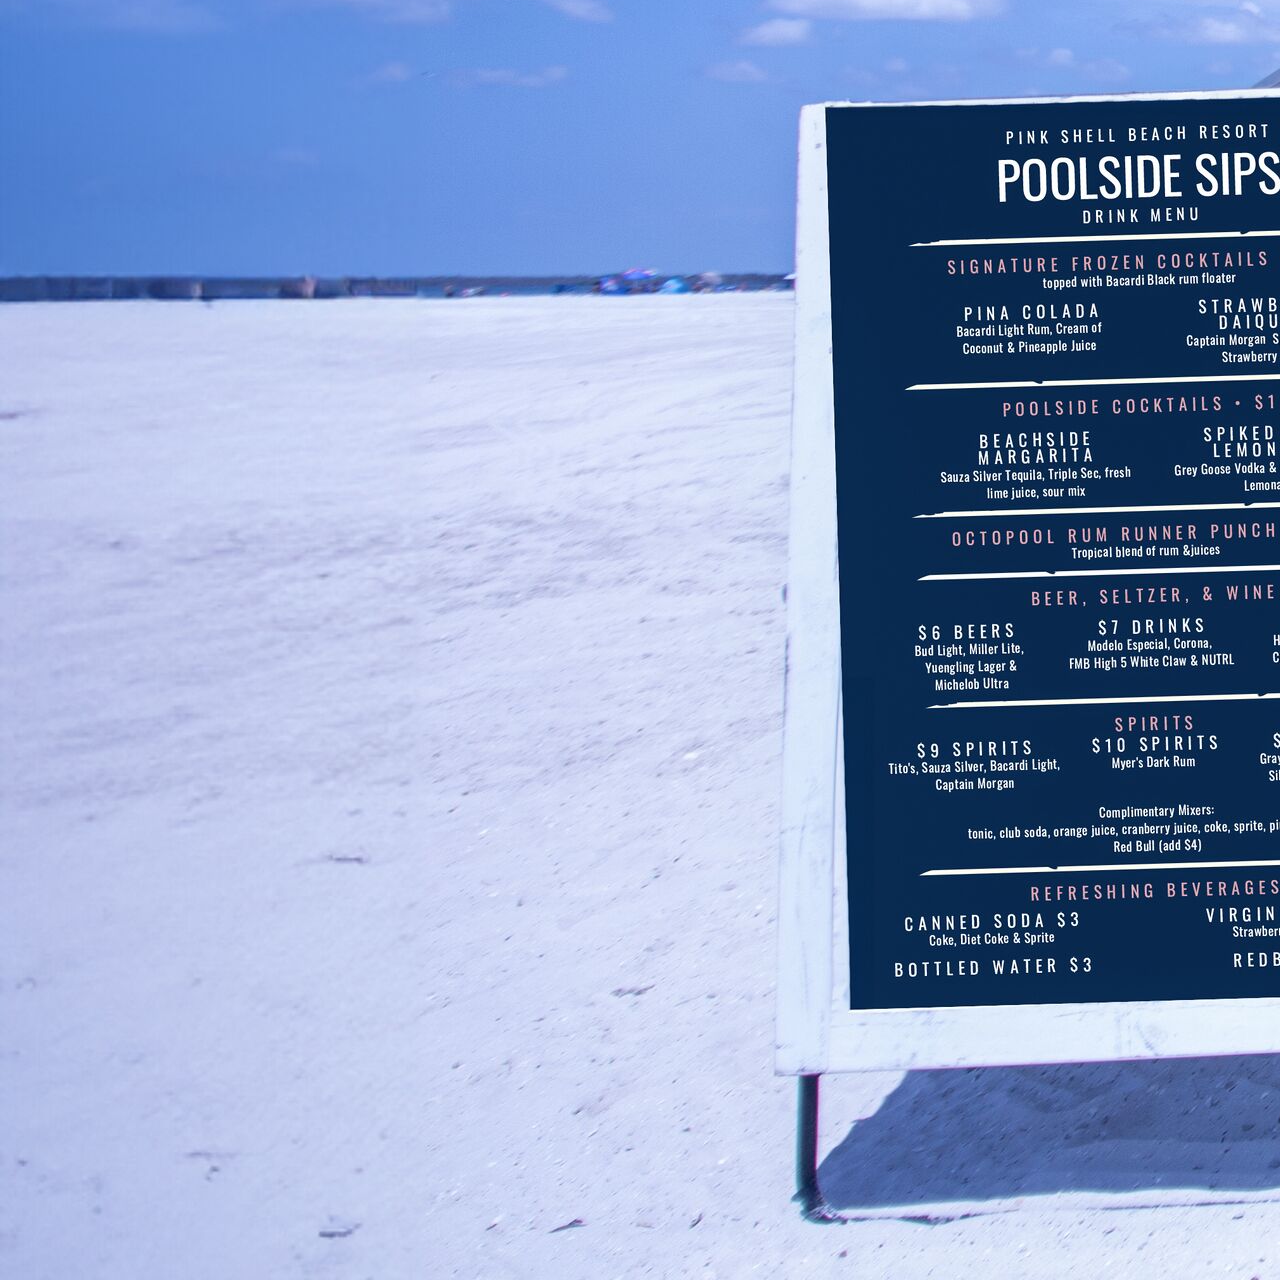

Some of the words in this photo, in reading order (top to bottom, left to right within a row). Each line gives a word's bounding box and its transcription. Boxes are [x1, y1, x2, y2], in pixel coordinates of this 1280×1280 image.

[1005, 130, 1049, 145] PINK
[1060, 128, 1116, 144] SHELL
[1128, 125, 1186, 142] BEACH
[1199, 123, 1269, 140] RESORT
[997, 153, 1183, 203] POOLSIDE
[1082, 208, 1139, 225] DRINK
[1150, 206, 1199, 223] MENU
[947, 257, 1058, 275] SIGNATURE
[1071, 254, 1144, 272] FROZEN
[1157, 250, 1267, 270] COCKTAILS
[1042, 275, 1077, 291] topped
[1080, 275, 1103, 288] with
[1105, 274, 1145, 287] Bacardi
[1147, 273, 1176, 286] Black
[1178, 275, 1199, 285] rum
[1201, 271, 1237, 284] floater
[964, 305, 1009, 322] PINA
[1022, 302, 1099, 320] COLADA
[956, 324, 996, 338] Bacardi
[998, 323, 1025, 338] Light
[1027, 323, 1053, 336] Rum,
[1055, 322, 1089, 335] Cream
[1091, 321, 1103, 334] of
[962, 342, 1004, 355] Coconut
[1007, 341, 1015, 354] &
[1018, 339, 1068, 355] Pineapple
[1070, 339, 1097, 352] Juice
[1186, 334, 1226, 349] Captain
[1229, 333, 1266, 348] Morgan
[1221, 350, 1278, 364] Strawberry
[1002, 399, 1099, 418] POOLSIDE
[1112, 395, 1222, 415] COCKTAILS
[979, 430, 1090, 449] BEACHSIDE
[1203, 425, 1274, 443] SPIKED
[978, 447, 1093, 466] MARGARITA
[940, 471, 970, 484] Sauza
[972, 470, 1003, 482] Silver
[1004, 468, 1045, 484] Tequila,
[1047, 467, 1078, 482] Triple
[1080, 466, 1102, 480] Sec,
[1104, 465, 1131, 479] fresh
[1174, 464, 1198, 478] Grey
[1200, 463, 1231, 476] Goose
[1234, 461, 1266, 475] Vodka
[1268, 461, 1277, 474] &
[952, 528, 1055, 547] OCTOPOOL
[1068, 527, 1107, 544] RUM
[1121, 524, 1197, 542] RUNNER
[1210, 522, 1275, 539] PUNCH
[1071, 546, 1113, 561] Tropical
[1115, 545, 1143, 558] blend
[1145, 545, 1156, 557] of
[1159, 546, 1180, 557] rum
[1182, 544, 1221, 558] &juices
[1031, 590, 1086, 607] BEER,
[1099, 587, 1189, 605] SELTZER,
[1202, 586, 1213, 601] &
[1226, 584, 1275, 601] WINE
[918, 624, 941, 641] $6
[954, 622, 1014, 640] BEERS
[1098, 619, 1119, 636] $7
[1132, 617, 1204, 635] DRINKS
[914, 644, 934, 657] Bud
[937, 643, 966, 658] Light,
[969, 642, 999, 655] Miller
[1001, 642, 1025, 656] Lite,
[1087, 639, 1124, 652] Modelo
[1126, 637, 1171, 653] Especial,
[1173, 637, 1213, 650] Corona,
[924, 660, 975, 676] Yuengling
[977, 660, 1007, 675] Lager
[1009, 659, 1017, 672] &
[935, 677, 980, 691] Michelob
[982, 677, 1010, 690] Ultra
[1114, 715, 1193, 733] SPIRITS
[916, 742, 939, 760] $9
[952, 739, 1032, 757] SPIRITS
[1091, 737, 1126, 754] $10
[1139, 734, 1218, 752] SPIRITS
[888, 762, 919, 776] Tito's,
[921, 761, 951, 774] Sauza
[954, 760, 987, 774] Silver,
[989, 759, 1029, 772] Bacardi
[1031, 758, 1061, 773] Light,
[1111, 756, 1144, 771] Myer's
[1146, 755, 1170, 768] Dark
[1173, 755, 1196, 768] Rum
[935, 778, 974, 793] Captain
[977, 777, 1015, 791] Morgan
[1098, 805, 1175, 820] Complimentary
[1178, 803, 1215, 816] Mixers:
[1113, 840, 1133, 853] Red
[1135, 839, 1155, 852] Bull
[1158, 838, 1181, 854] (add
[1184, 838, 1202, 853] $4)
[1030, 883, 1153, 902] REFRESHING
[1167, 879, 1280, 898] BEVERAGES
[904, 914, 980, 932] CANNED
[993, 912, 1044, 929] SODA
[1057, 911, 1079, 929] $3
[1205, 905, 1275, 923] VIRGIN
[894, 960, 979, 978] BOTTLED
[992, 957, 1056, 975] WATER
[1069, 956, 1092, 974] $3
